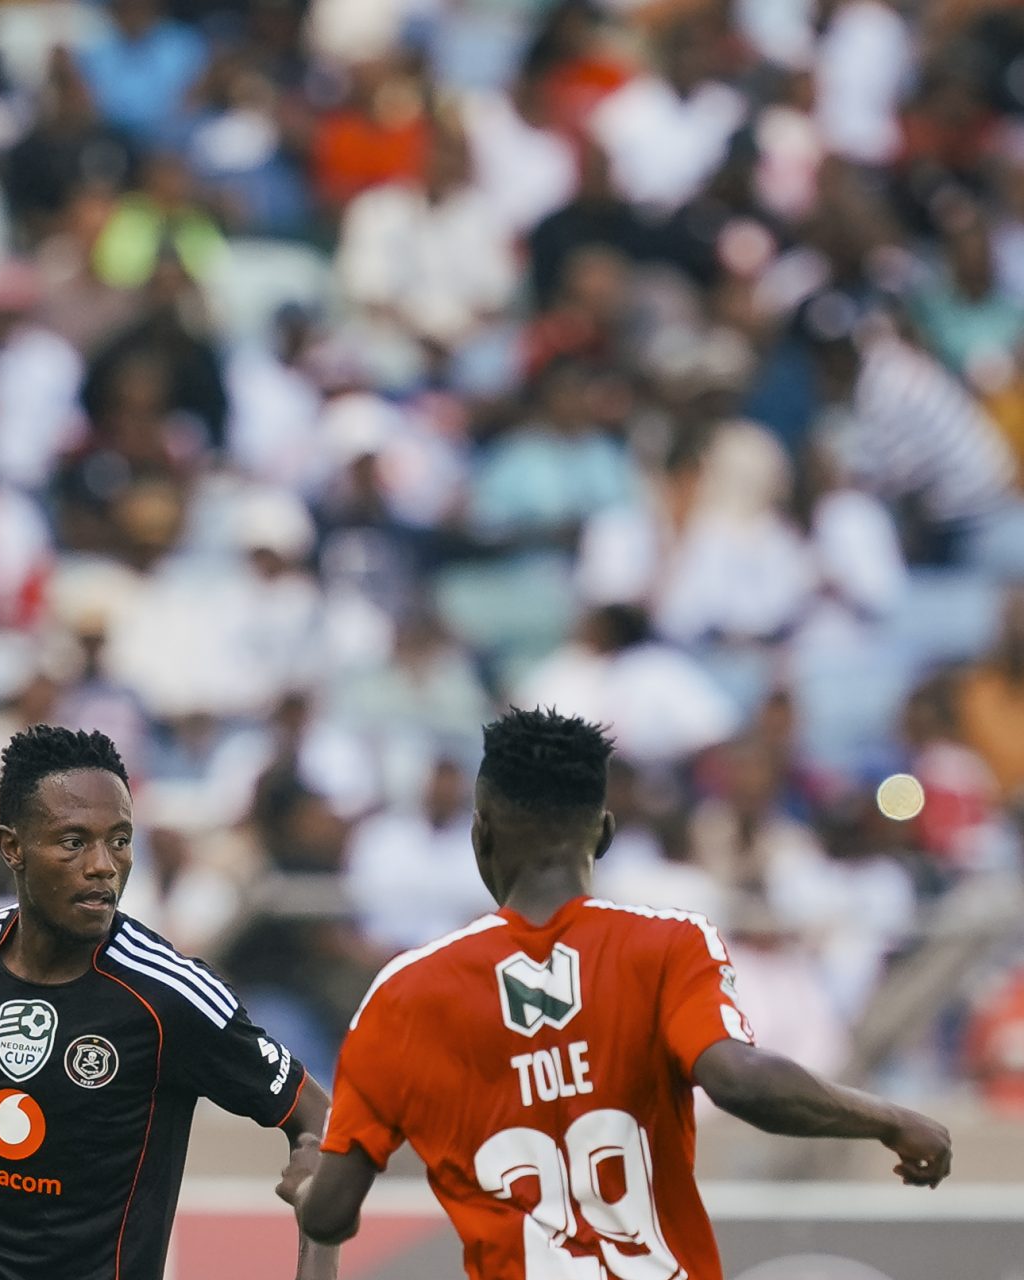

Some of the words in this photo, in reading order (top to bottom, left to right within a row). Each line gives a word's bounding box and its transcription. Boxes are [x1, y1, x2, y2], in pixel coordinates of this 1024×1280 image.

[0, 1042, 44, 1053] NEDBANK
[5, 1051, 36, 1065] CUP
[511, 1041, 593, 1106] TOLE
